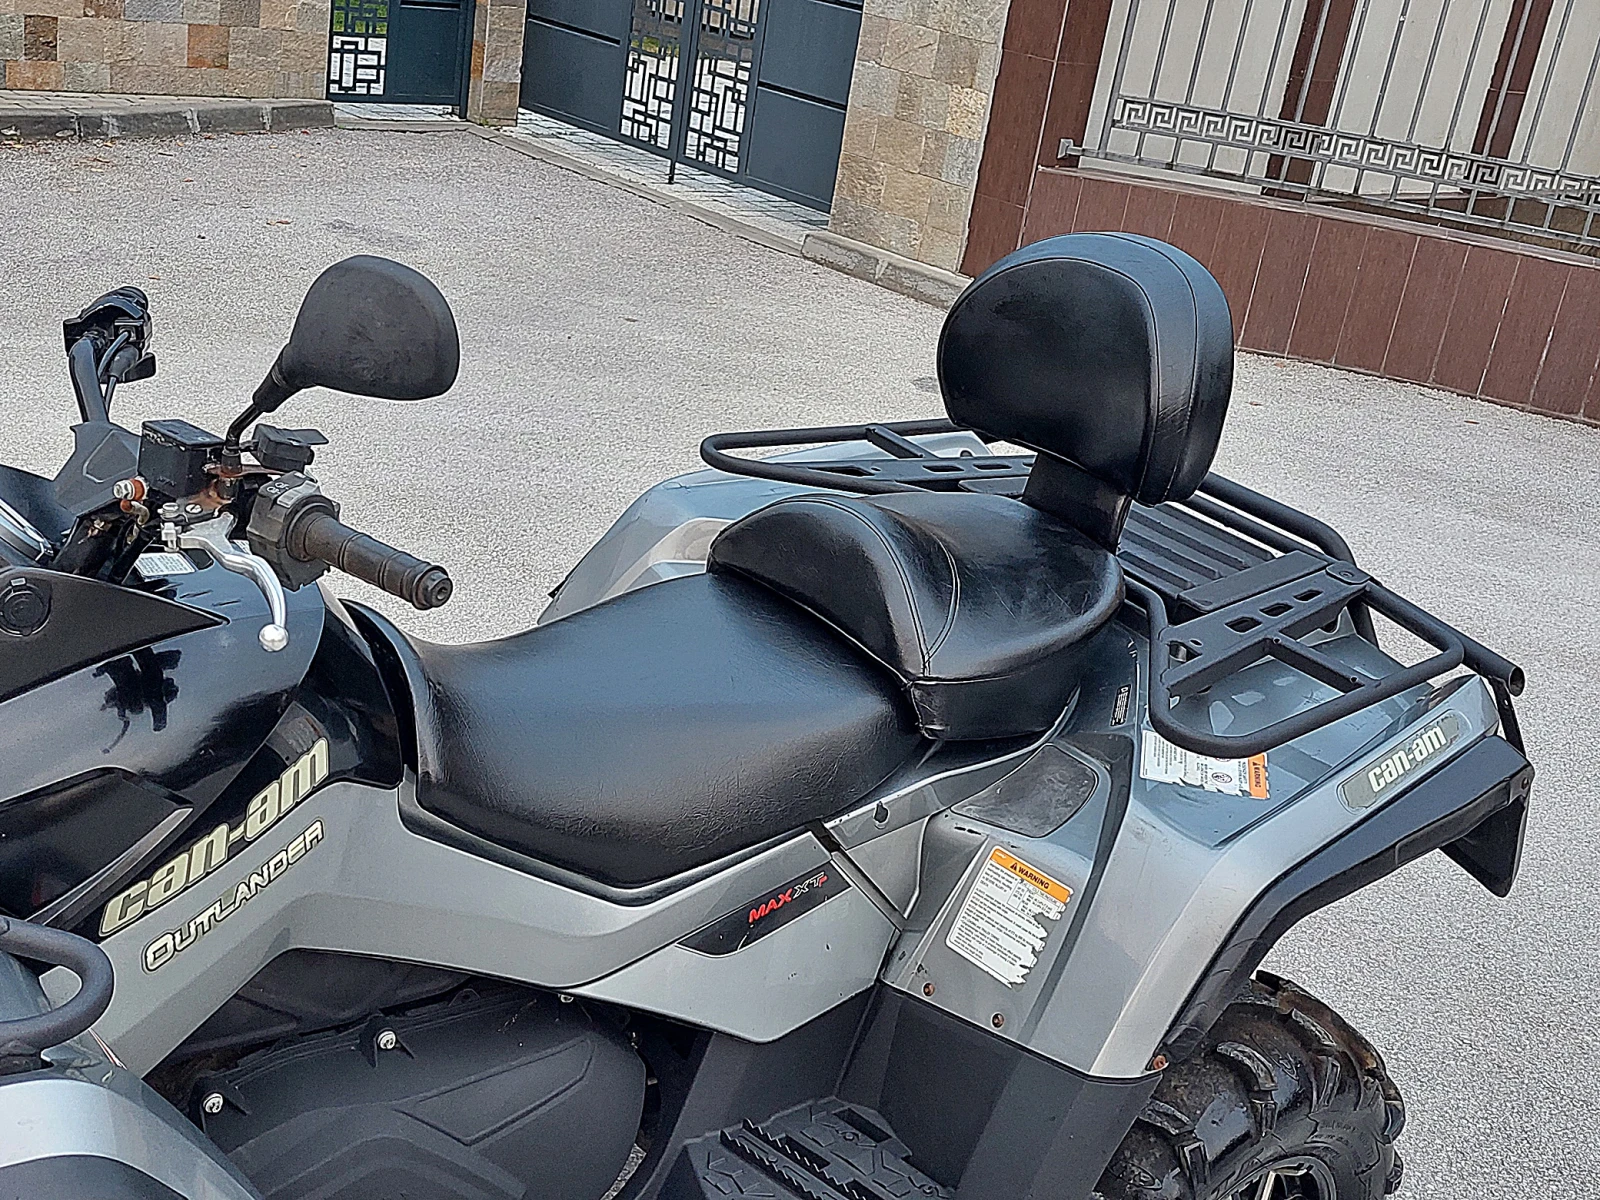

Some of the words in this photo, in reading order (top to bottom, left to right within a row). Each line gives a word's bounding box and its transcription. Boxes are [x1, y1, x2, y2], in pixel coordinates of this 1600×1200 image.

[1367, 726, 1447, 793] can-am
[101, 738, 328, 935] can-am
[144, 820, 324, 970] OUTLANDER
[748, 888, 793, 923] MAX
[1018, 867, 1050, 889] WARNING
